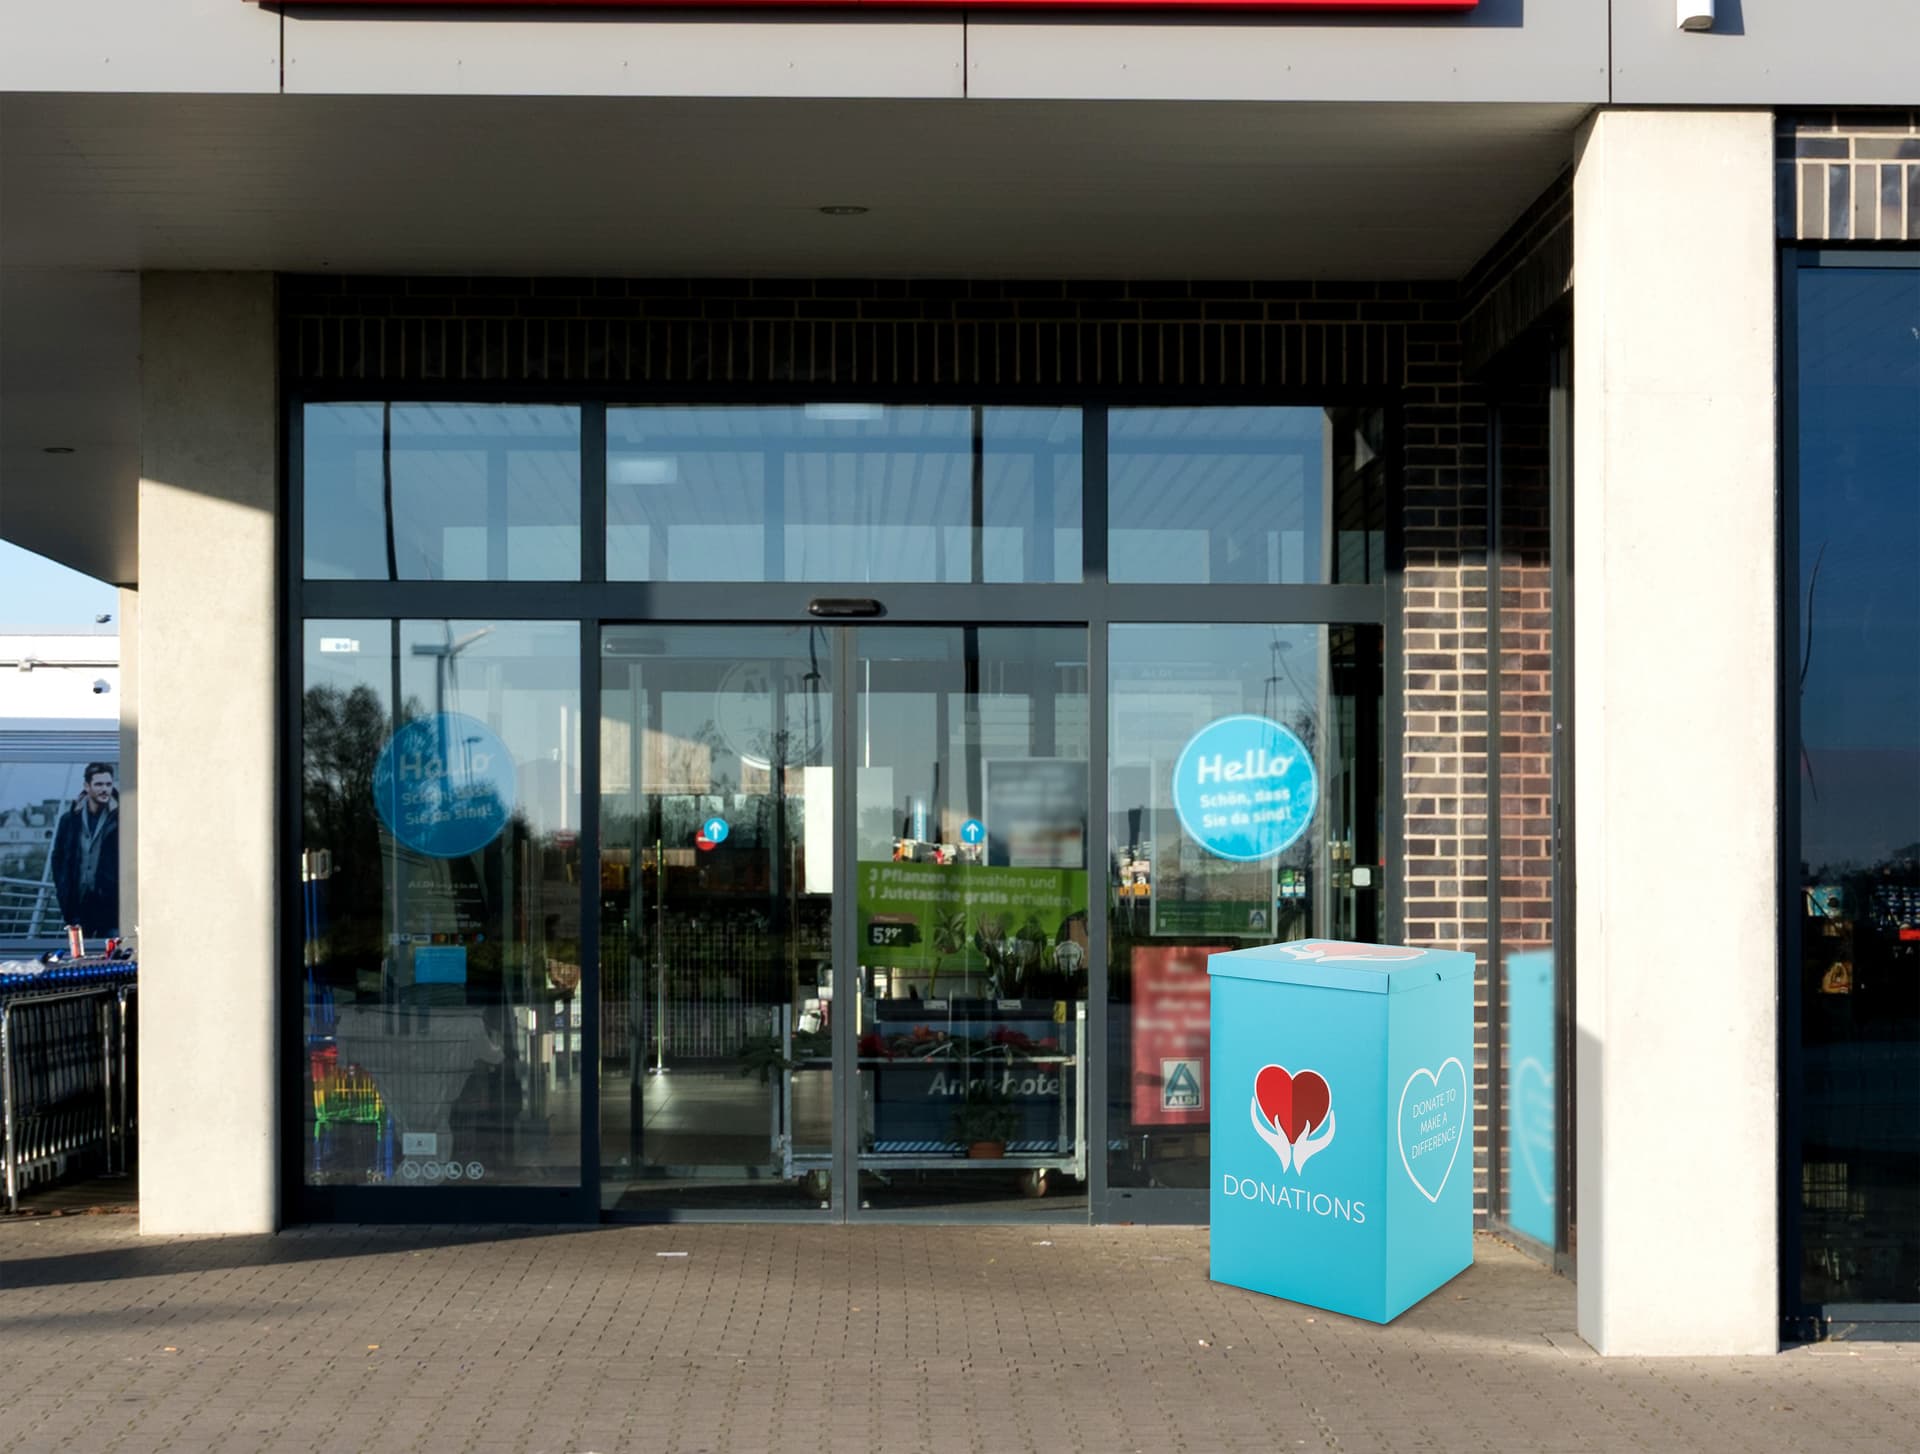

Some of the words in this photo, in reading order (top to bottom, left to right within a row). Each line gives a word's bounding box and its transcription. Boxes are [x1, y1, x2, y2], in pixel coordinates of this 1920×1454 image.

[1197, 749, 1294, 784] Hello
[1200, 791, 1251, 808] Schön,
[1255, 788, 1290, 802] dass
[1202, 814, 1228, 828] Sie
[881, 869, 946, 886] Pflanzen
[1029, 875, 1057, 889] und
[880, 886, 960, 900] Jutetasche
[965, 889, 1009, 905] gratis
[1168, 1095, 1198, 1106] ALDI
[1412, 1093, 1444, 1118] DONATE
[1445, 1088, 1456, 1103] TO
[1420, 1114, 1441, 1135] MAKE
[1442, 1111, 1448, 1125] A
[1411, 1127, 1456, 1159] DIFFERENCE
[1223, 1174, 1366, 1224] DONATIONS
